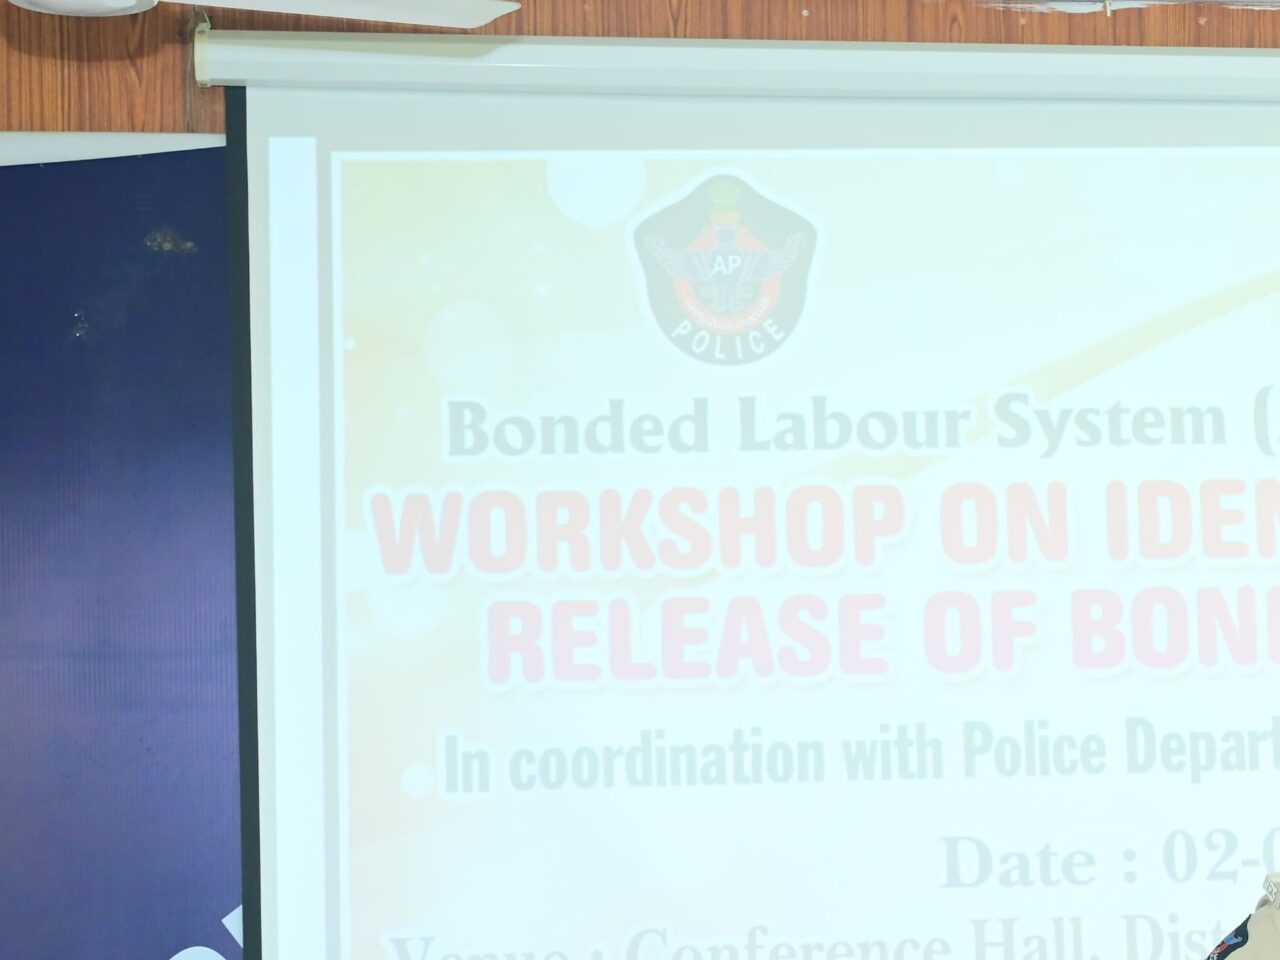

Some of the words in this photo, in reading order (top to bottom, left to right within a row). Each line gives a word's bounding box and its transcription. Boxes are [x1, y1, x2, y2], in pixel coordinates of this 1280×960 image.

[711, 254, 743, 276] AP
[671, 319, 785, 360] POLICE
[447, 397, 709, 457] Bonded
[738, 395, 971, 454] Labour
[996, 392, 1227, 459] System
[370, 483, 907, 576] WORKSHOP
[940, 480, 1069, 565] ON
[487, 592, 889, 685] RELEASE
[923, 588, 1038, 676] OF
[445, 734, 491, 794] In
[509, 725, 825, 792] coordination
[842, 721, 944, 782] with
[963, 718, 1107, 779] Police
[938, 834, 1097, 890] Date
